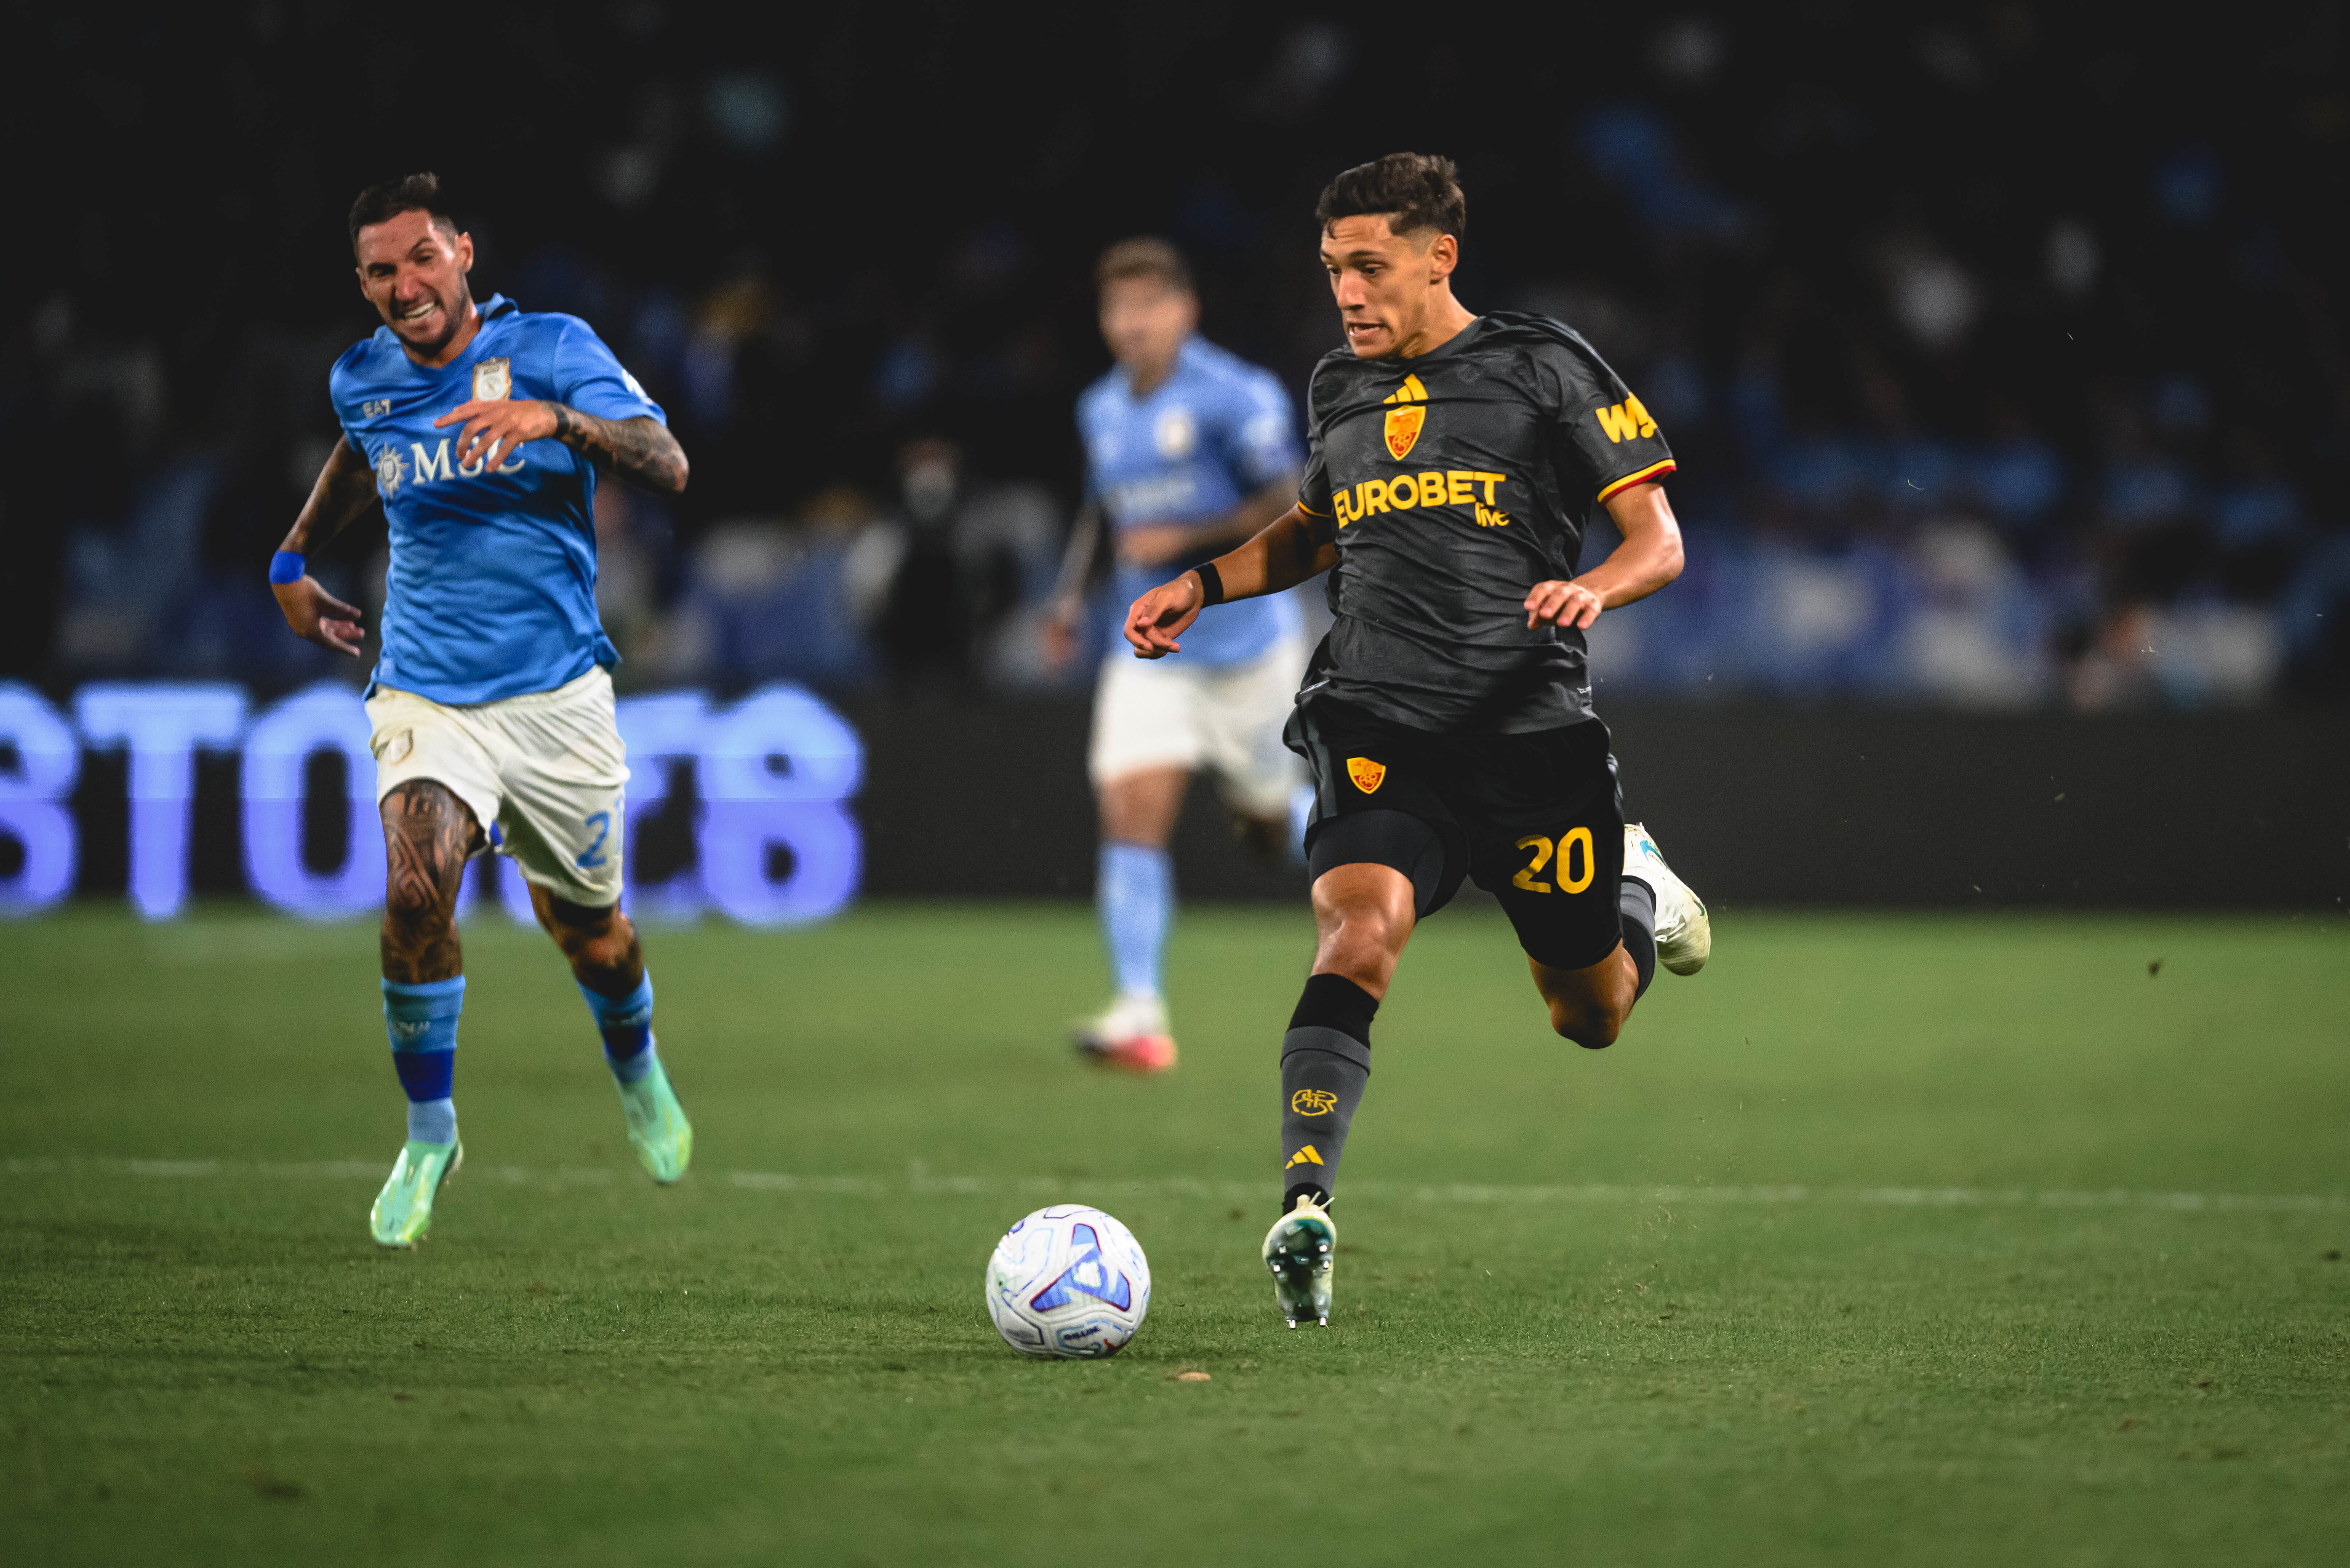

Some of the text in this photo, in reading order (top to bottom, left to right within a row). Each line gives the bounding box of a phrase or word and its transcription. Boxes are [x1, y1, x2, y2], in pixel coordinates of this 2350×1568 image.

[363, 398, 391, 418] EA7
[1333, 470, 1506, 529] EUROBET
[1475, 501, 1509, 527] live
[1512, 827, 1595, 894] 20
